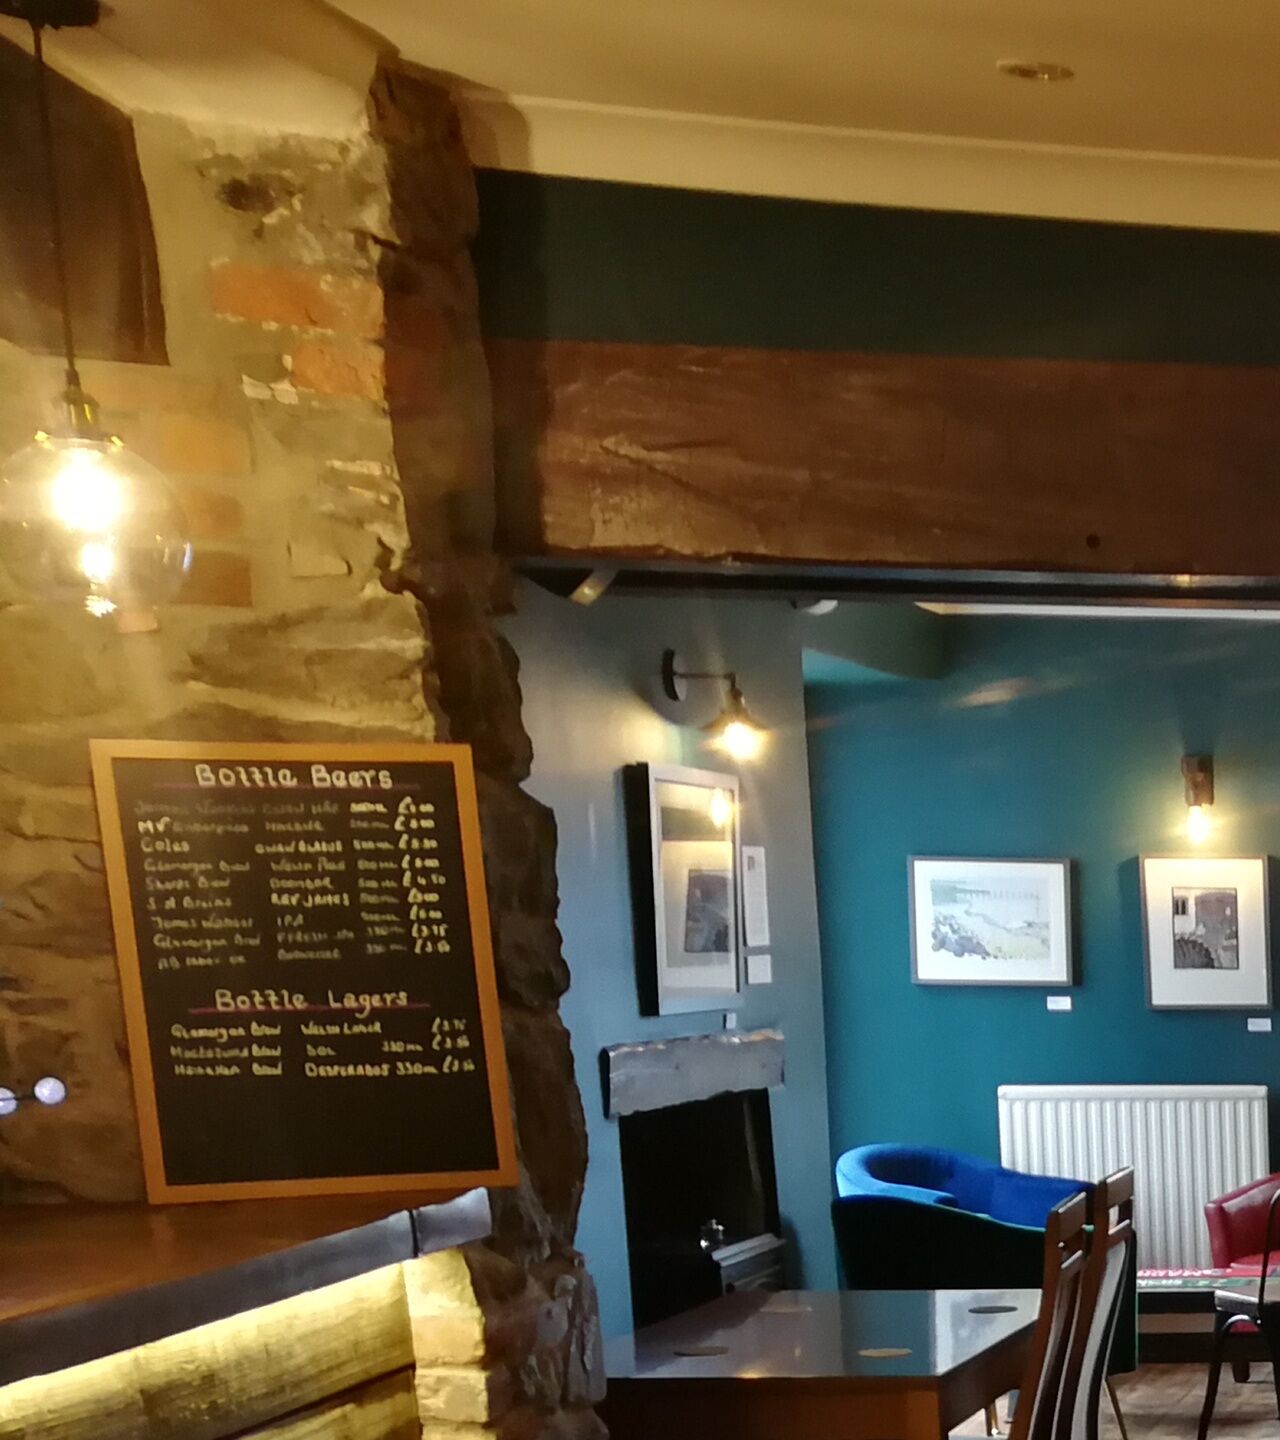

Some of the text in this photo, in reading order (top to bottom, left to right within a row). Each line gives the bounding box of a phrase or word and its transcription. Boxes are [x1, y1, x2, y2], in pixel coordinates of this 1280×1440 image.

[195, 763, 393, 790] Bottle Beers
[214, 988, 408, 1019] Bottle Lagers
